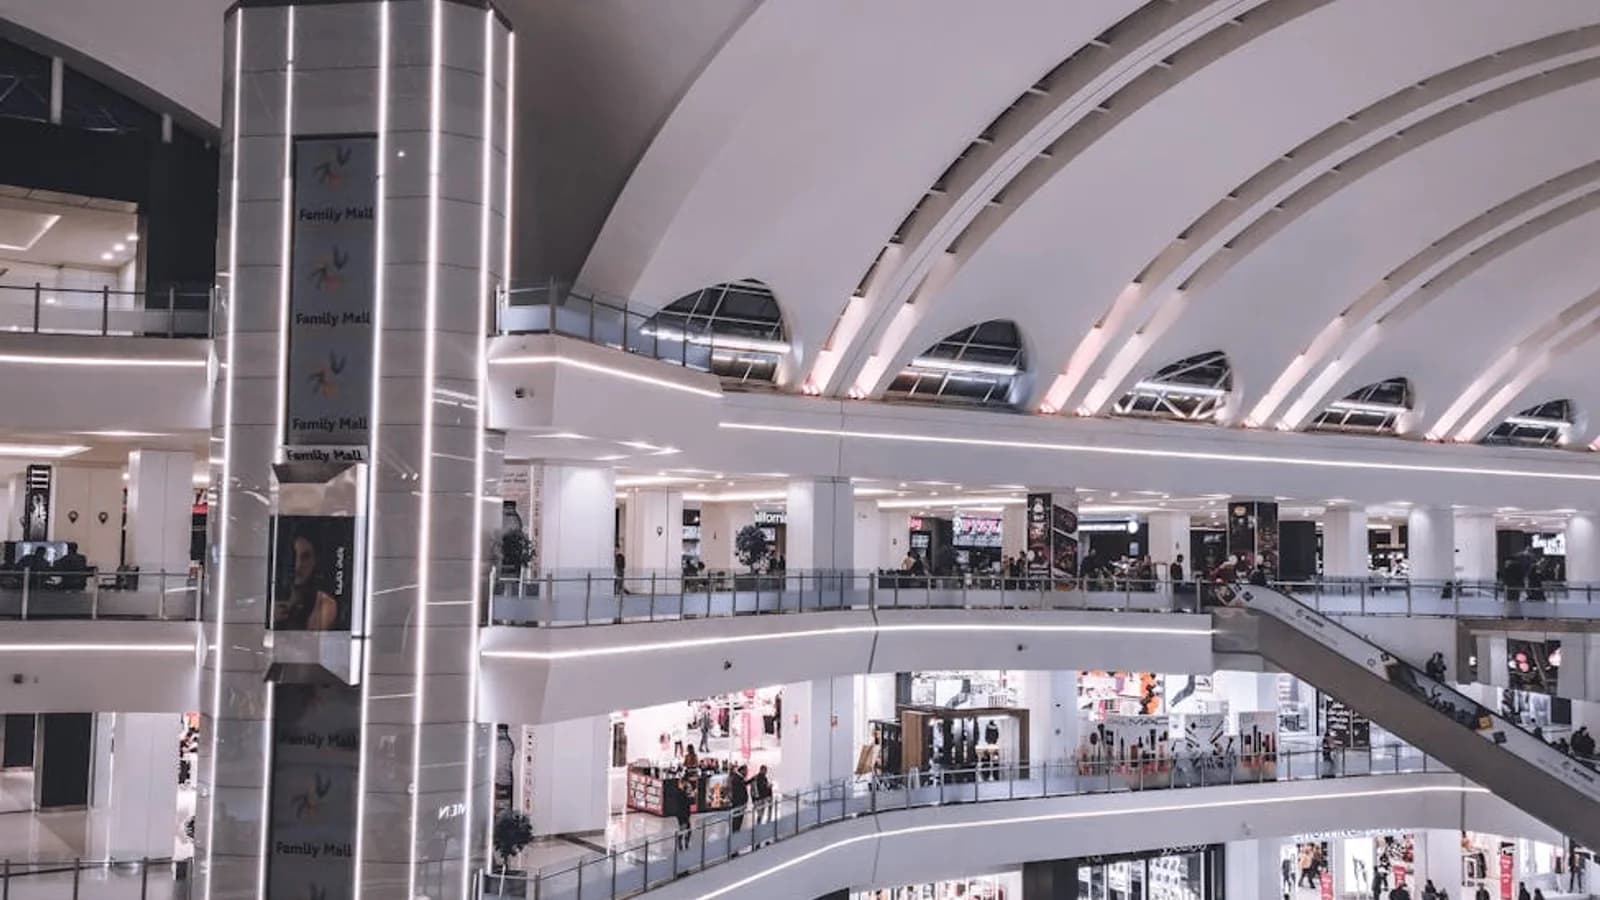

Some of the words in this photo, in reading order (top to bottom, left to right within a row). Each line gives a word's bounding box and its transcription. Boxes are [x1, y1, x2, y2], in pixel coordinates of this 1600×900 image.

[300, 207, 341, 223] Family
[345, 207, 374, 219] Mall
[296, 312, 338, 327] Family
[342, 312, 371, 324] Mall
[292, 417, 335, 432] Family
[340, 417, 368, 429] Mall
[287, 449, 329, 462] Family
[333, 449, 362, 461] Mall
[275, 841, 320, 858] Family
[323, 843, 353, 857] Mall
